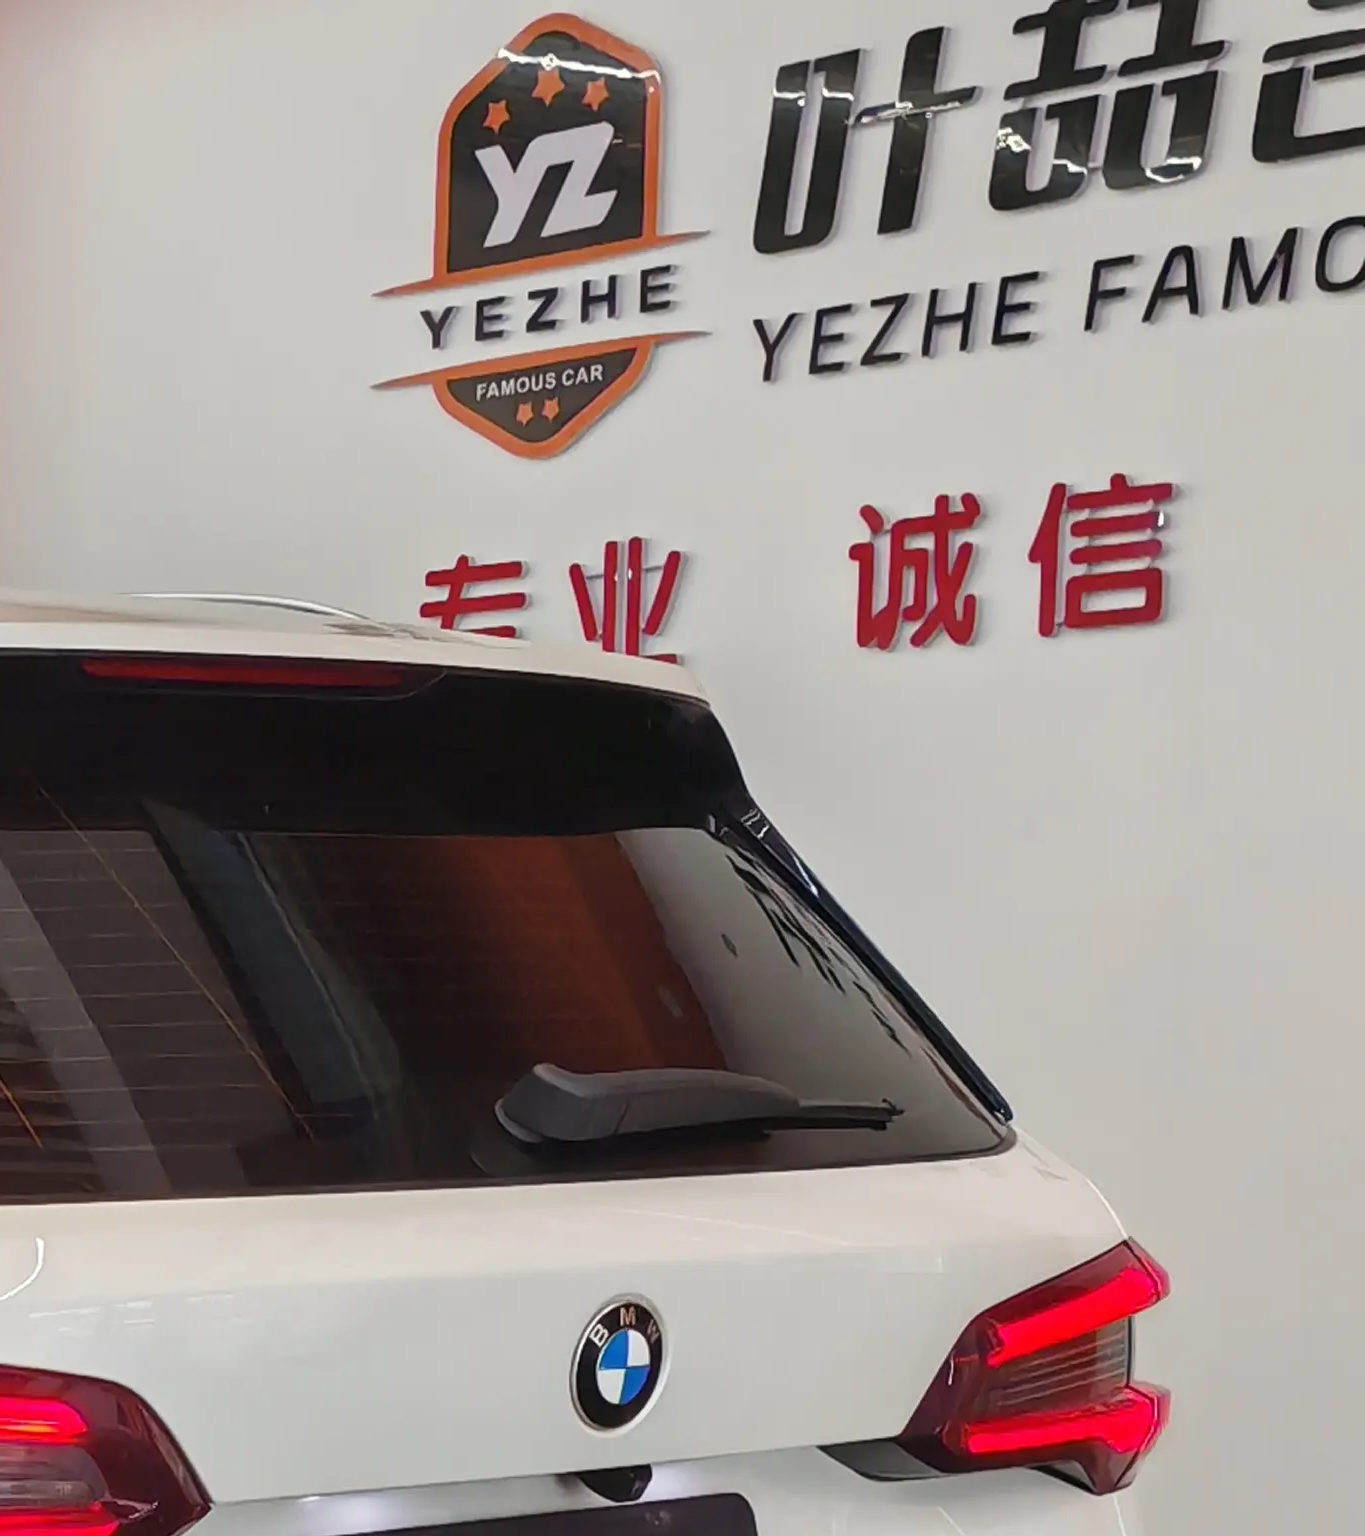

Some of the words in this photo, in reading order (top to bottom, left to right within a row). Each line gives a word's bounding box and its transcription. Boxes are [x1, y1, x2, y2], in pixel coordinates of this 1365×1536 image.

[475, 121, 618, 248] YZ
[420, 264, 677, 350] YEZHE
[752, 271, 1039, 383] YEZHE
[476, 371, 557, 402] FAMOUS
[561, 363, 604, 387] CAR
[848, 473, 1174, 651] 诚信
[589, 1305, 660, 1348] BMW
